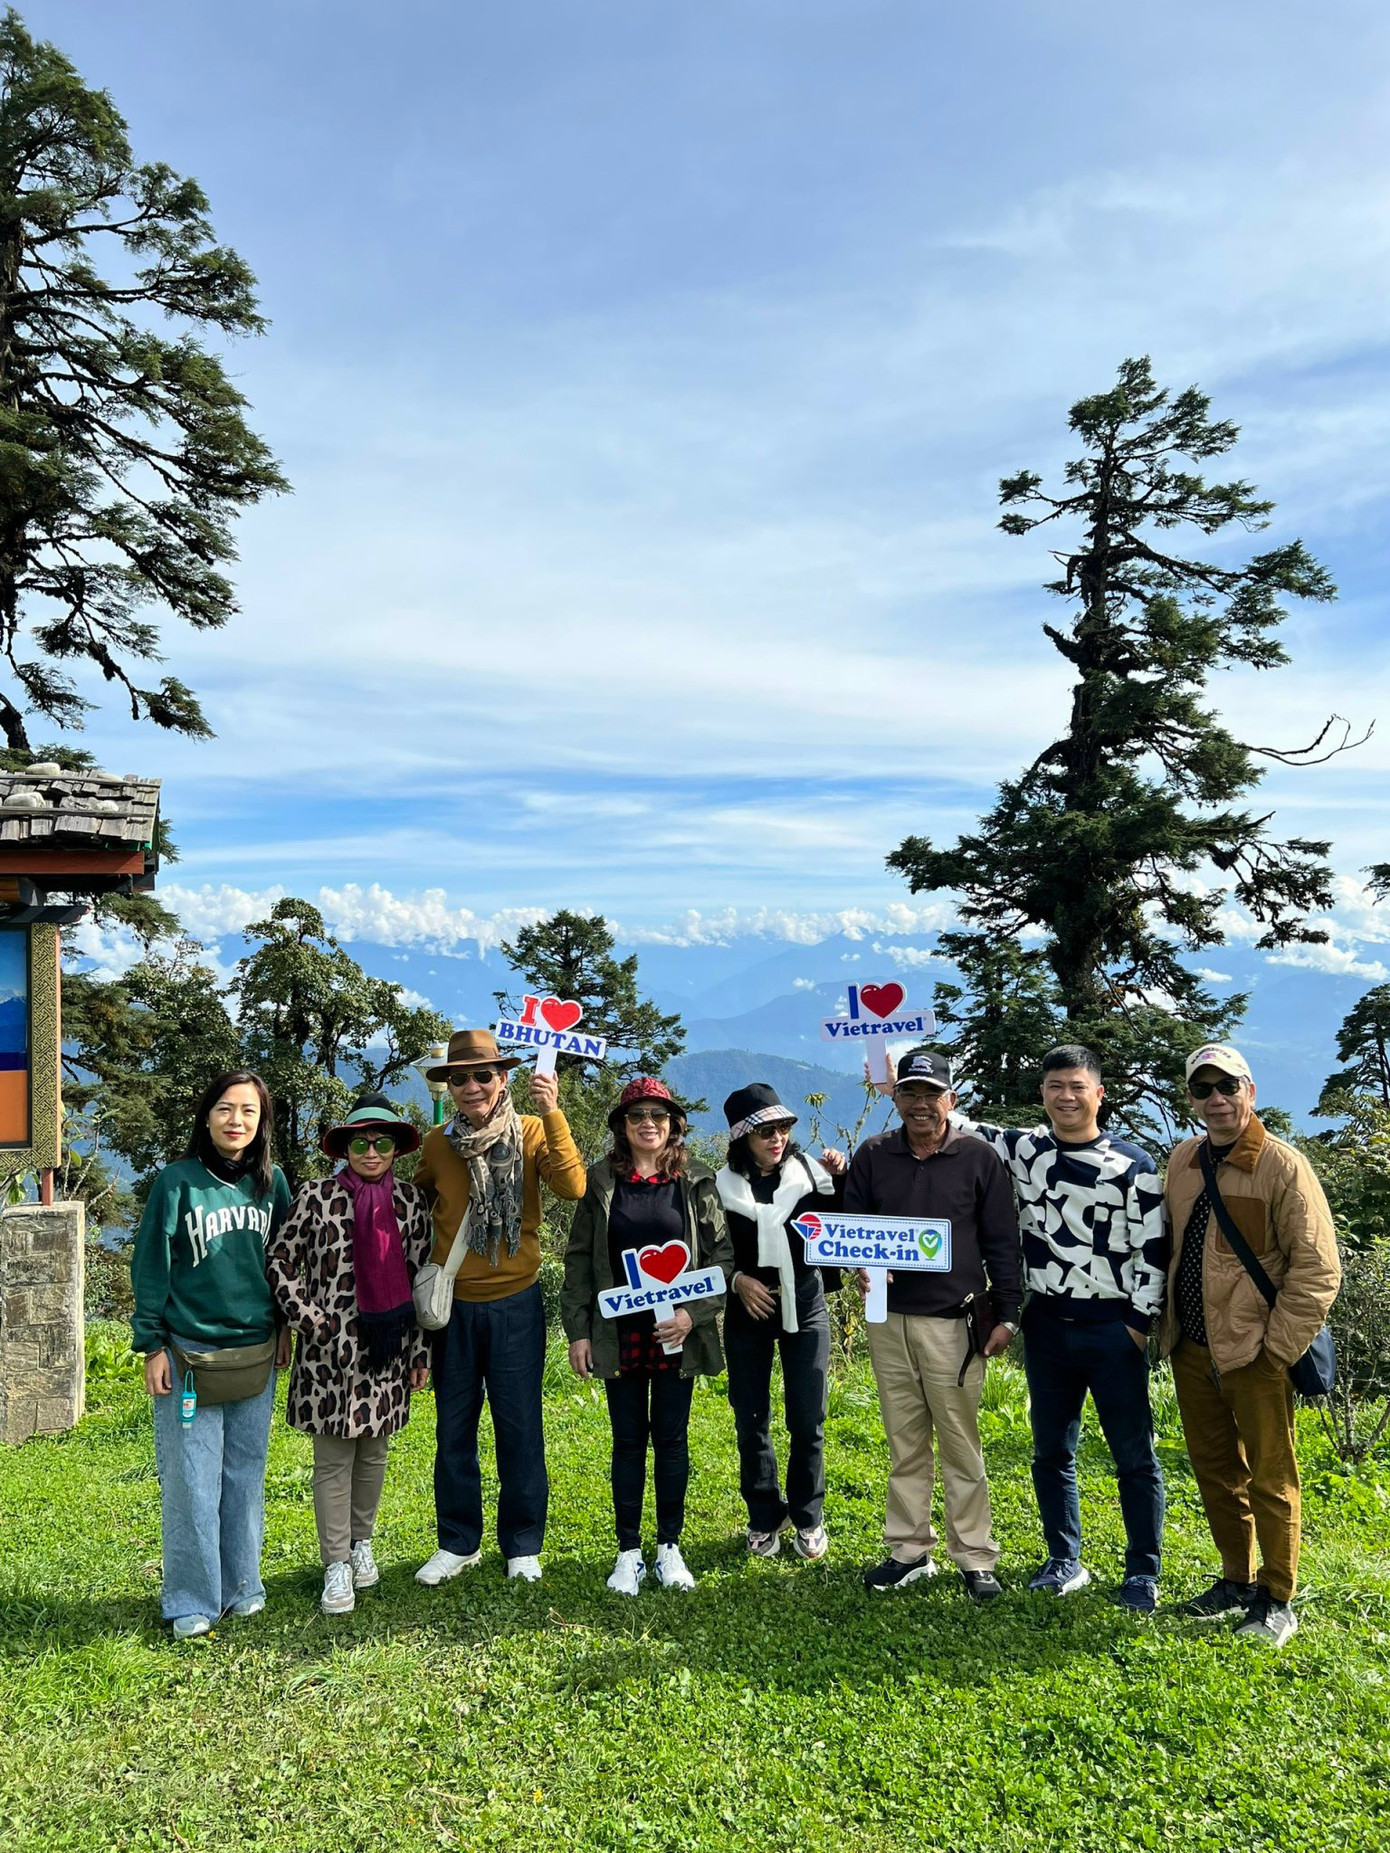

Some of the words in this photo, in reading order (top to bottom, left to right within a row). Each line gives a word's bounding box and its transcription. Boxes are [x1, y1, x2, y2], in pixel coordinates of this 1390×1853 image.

[520, 996, 540, 1026] I
[848, 985, 860, 1020] I
[498, 1021, 602, 1057] BHUTAN
[825, 1016, 924, 1038] Vietravel
[824, 1223, 915, 1242] Vietravel
[818, 1239, 919, 1262] Check-in
[624, 1252, 642, 1290] I
[604, 1276, 714, 1312] Vietravel
